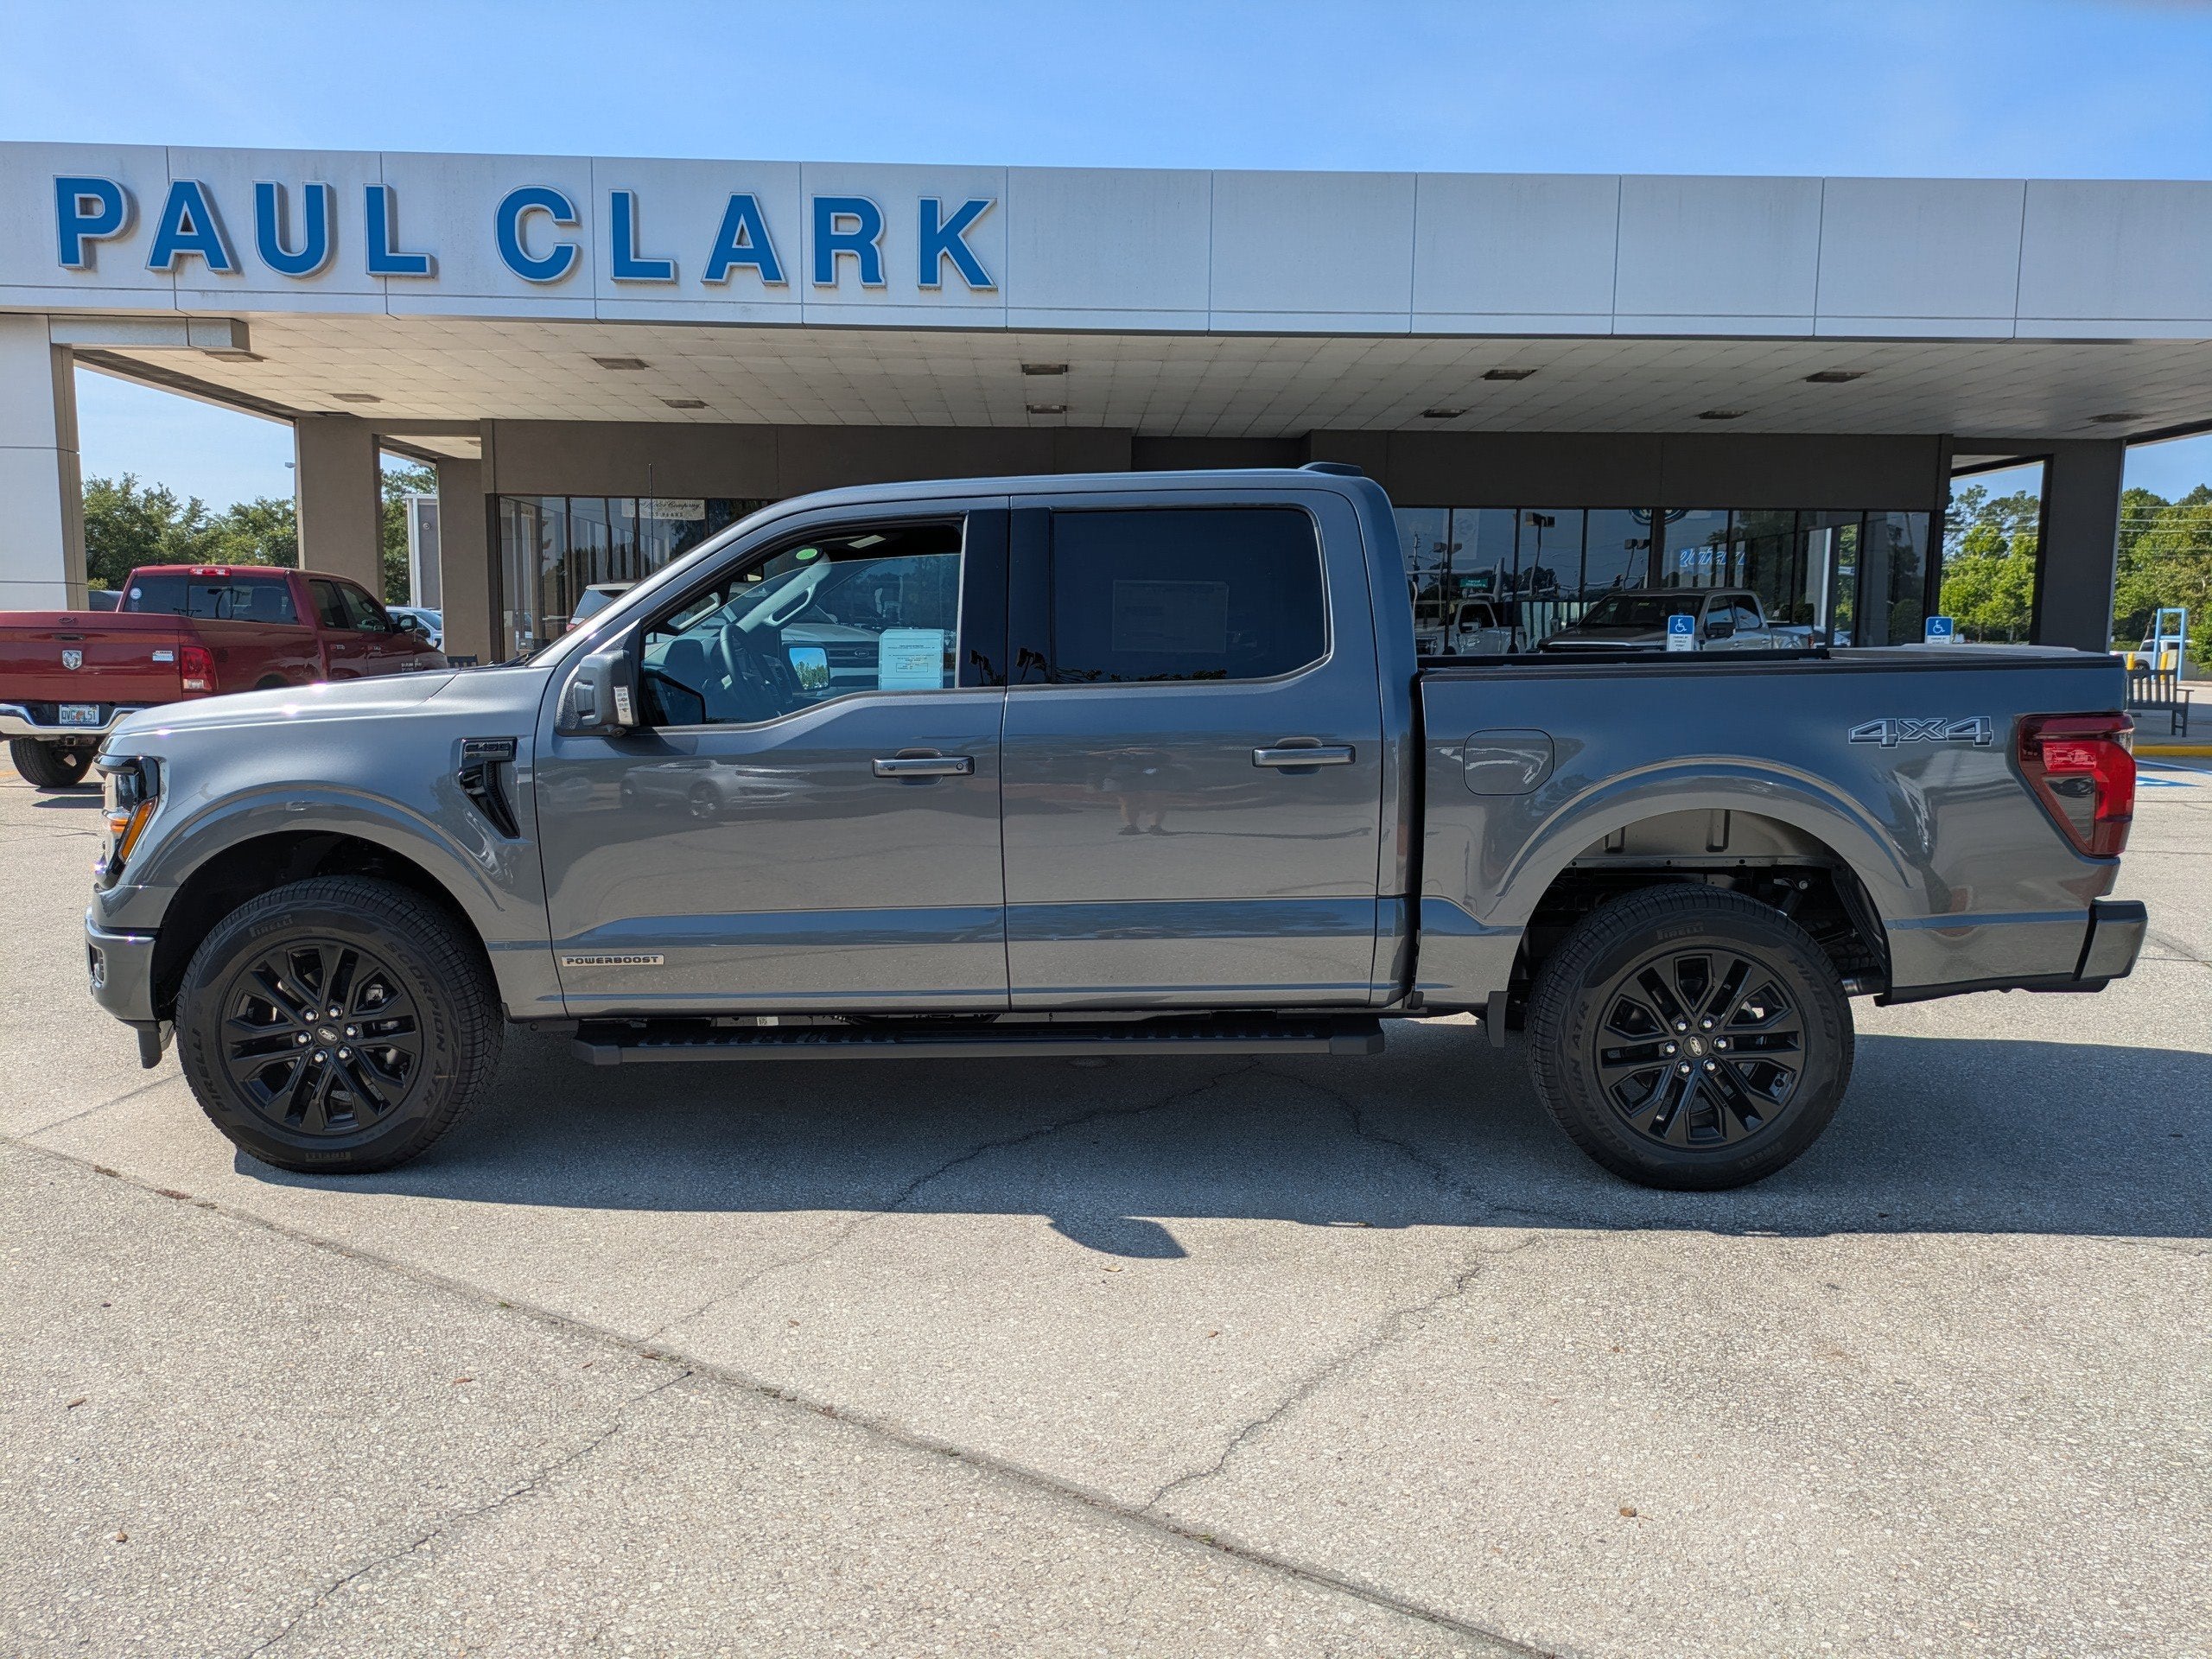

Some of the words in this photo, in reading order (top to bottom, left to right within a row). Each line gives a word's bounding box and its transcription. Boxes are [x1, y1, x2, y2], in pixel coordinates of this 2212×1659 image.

[53, 175, 436, 279] PAUL
[494, 184, 998, 291] CLARK
[567, 956, 658, 965] POWERBOOST
[191, 1027, 232, 1113] PIRELLI
